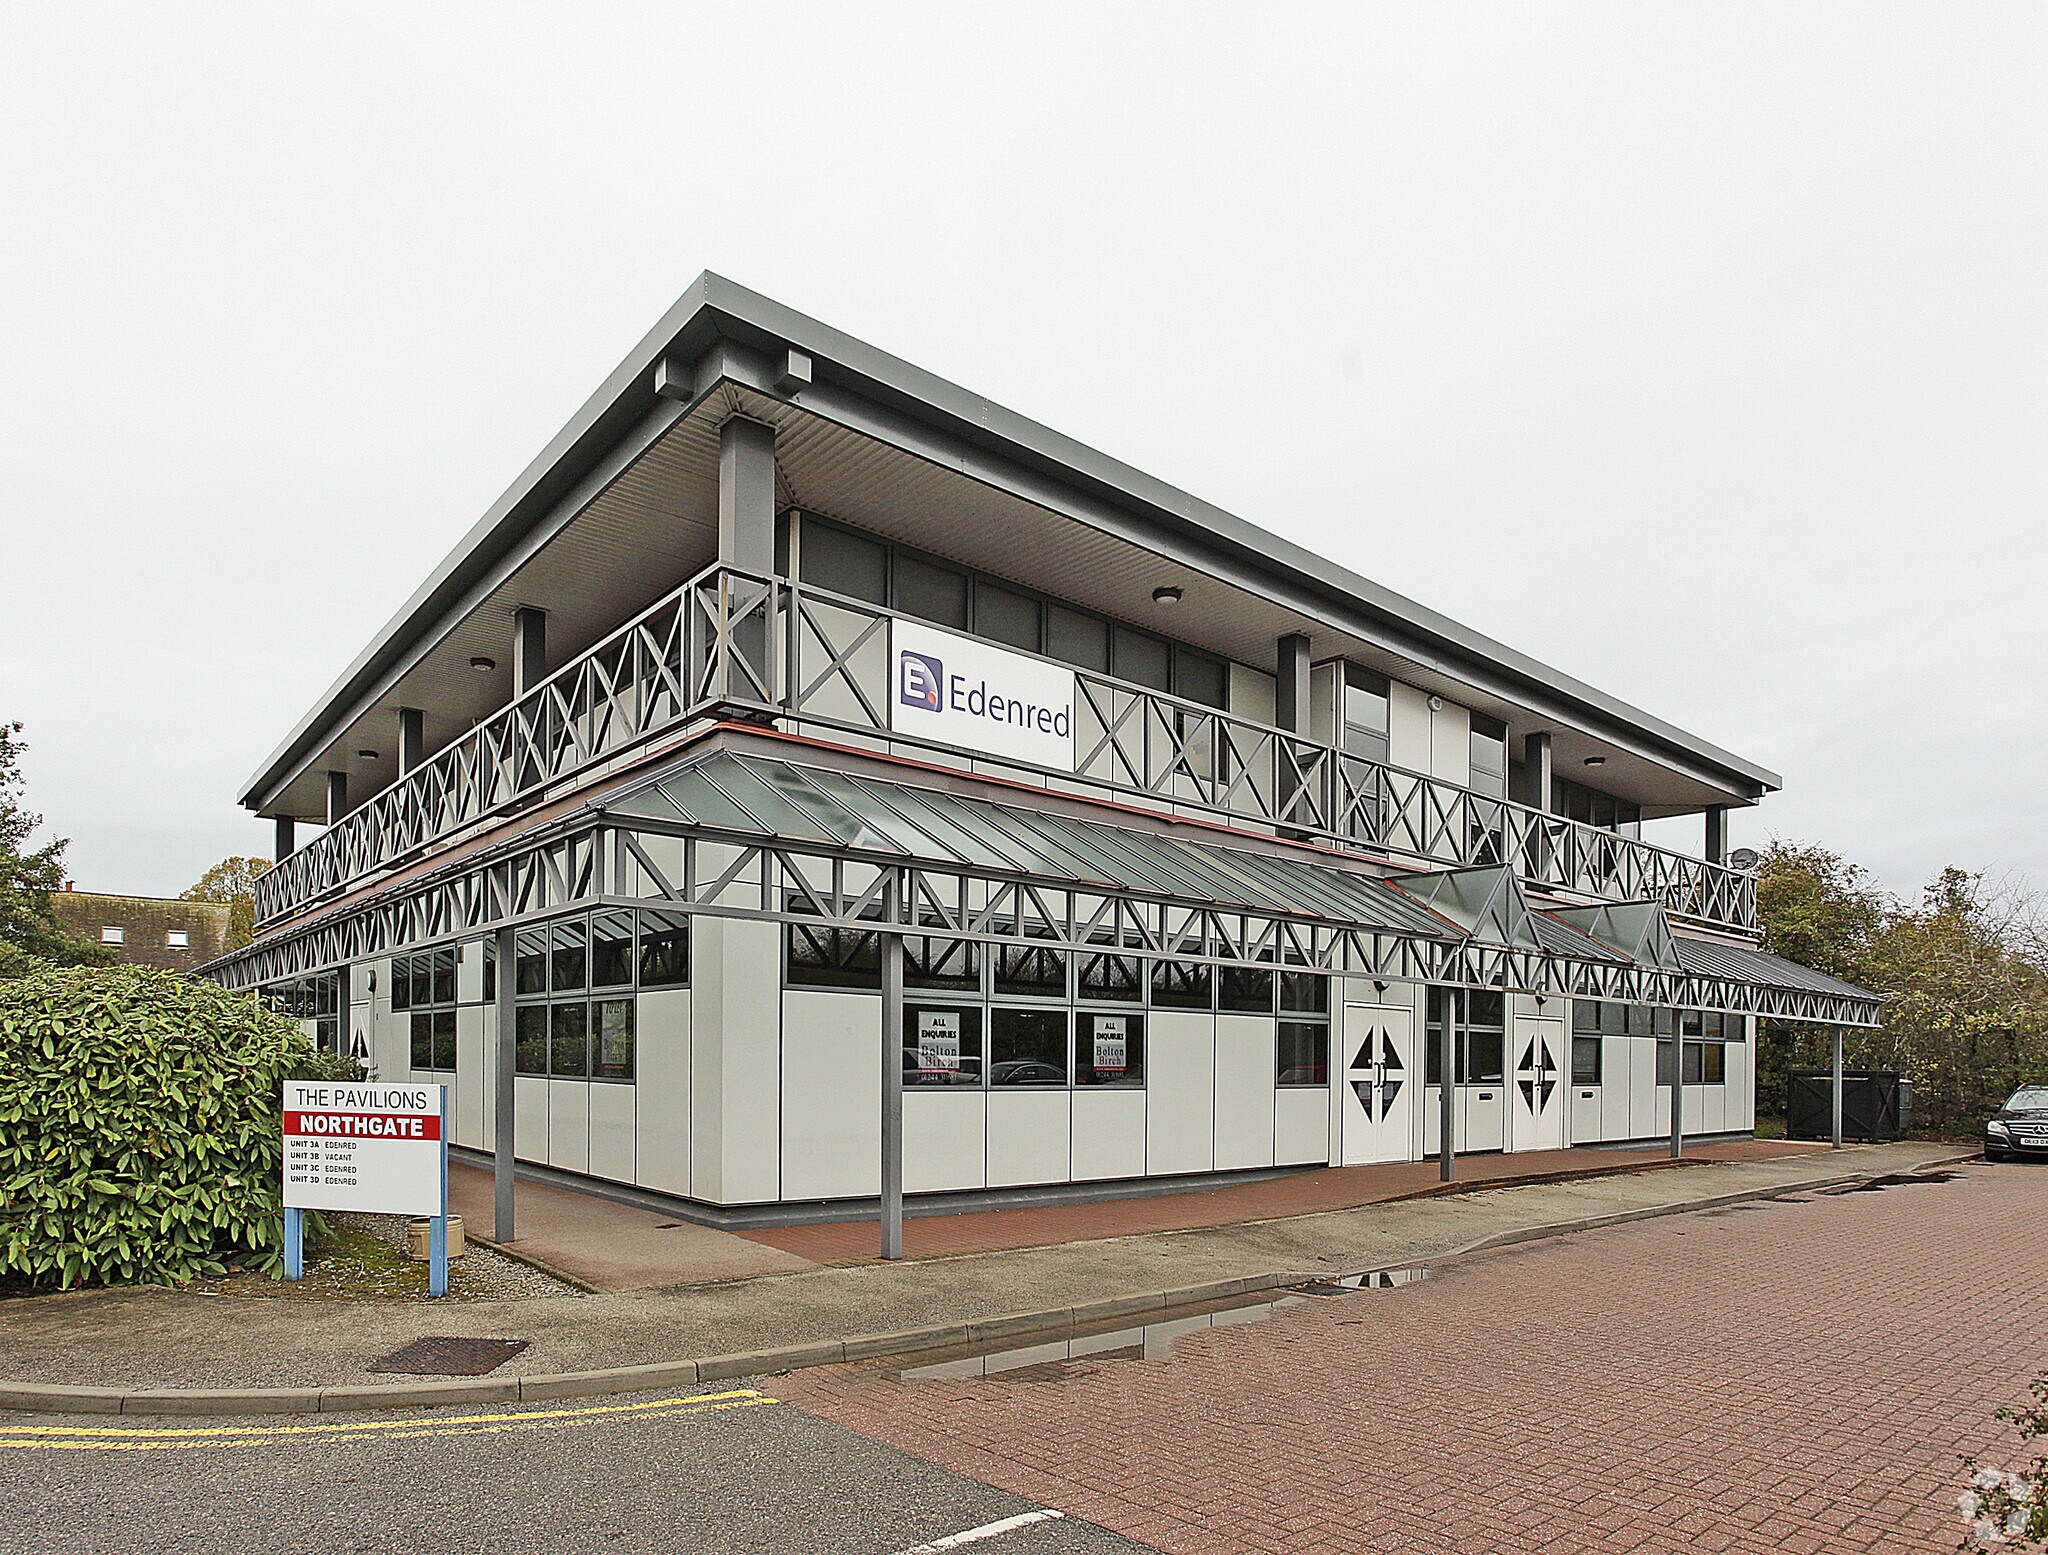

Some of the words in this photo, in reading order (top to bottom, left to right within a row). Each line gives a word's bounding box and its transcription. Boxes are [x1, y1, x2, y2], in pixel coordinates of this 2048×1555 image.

[951, 674, 1069, 738] Edenred
[922, 1030, 957, 1039] ENQUIRIES
[1096, 1033, 1124, 1041] ENQUIRIES
[922, 1045, 957, 1056] Bolton
[1096, 1046, 1124, 1056] Bolton
[925, 1056, 953, 1067] Birch
[1099, 1056, 1121, 1065] Birch
[296, 1089, 329, 1106] THE
[335, 1090, 427, 1109] PAVILIONS
[300, 1115, 424, 1137] NORTHGATE
[325, 1141, 357, 1149] EDENRED
[290, 1152, 308, 1160] UNIT
[325, 1153, 352, 1161] VACANT
[290, 1164, 308, 1172] UNIT
[310, 1164, 319, 1172] 3C
[325, 1165, 357, 1174] EDENRED
[310, 1176, 319, 1184] 3D
[325, 1177, 357, 1185] EDENRED
